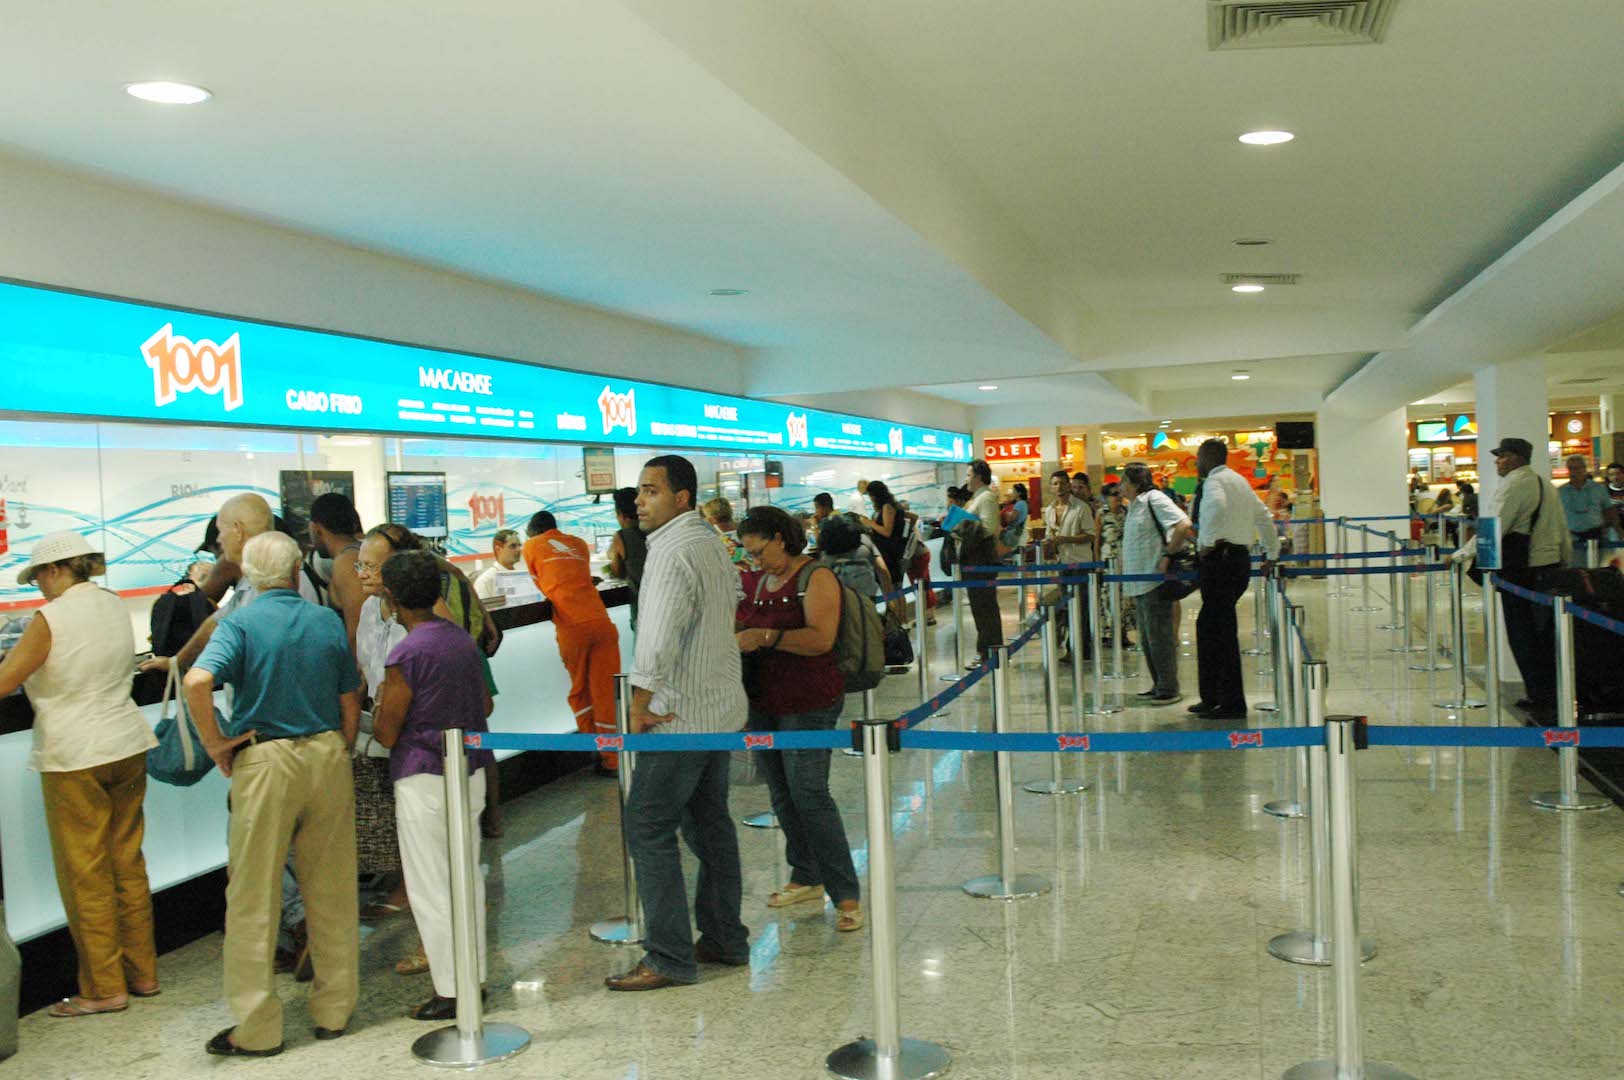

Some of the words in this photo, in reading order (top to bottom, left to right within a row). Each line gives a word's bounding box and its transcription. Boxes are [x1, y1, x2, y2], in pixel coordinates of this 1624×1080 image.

[140, 322, 243, 411] 1001
[418, 366, 493, 395] MACAENSE
[285, 389, 329, 413] CABO
[329, 393, 363, 415] FRIO
[597, 384, 637, 436] 1001
[469, 491, 505, 529] 1001
[744, 733, 774, 749] 1001
[1056, 734, 1091, 750] 1001
[1227, 731, 1263, 748] 1001
[1542, 729, 1580, 746] 1001
